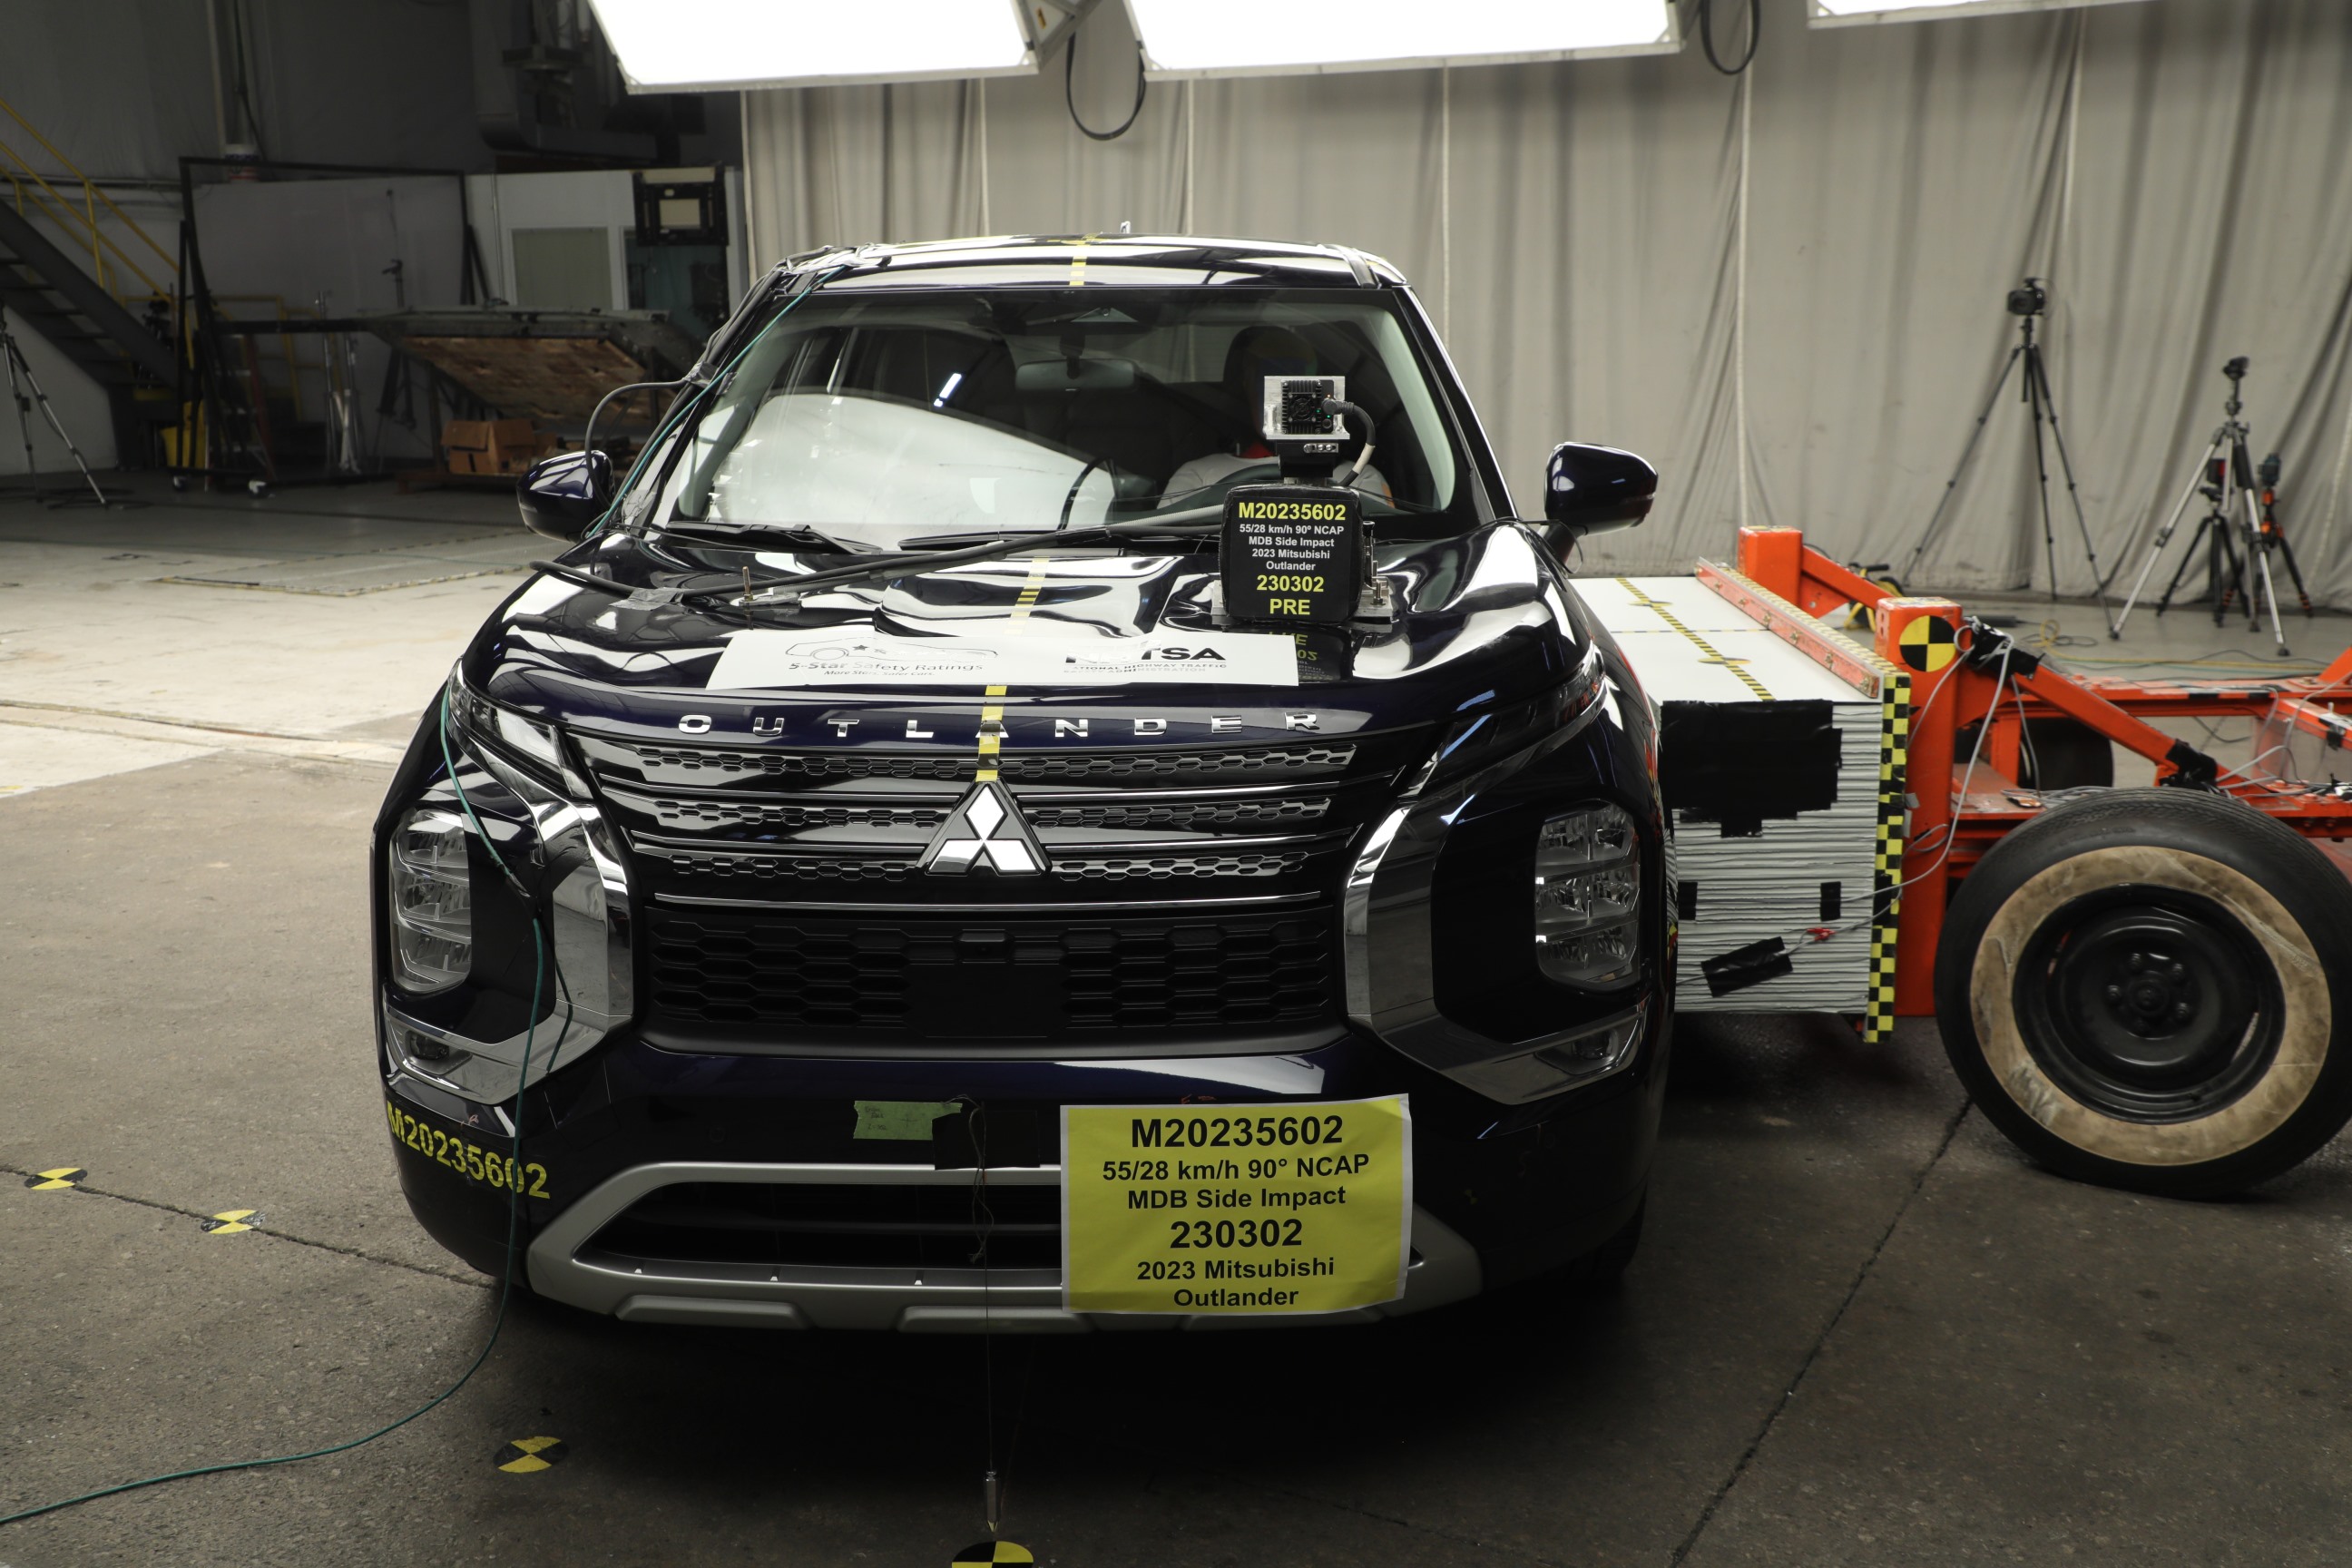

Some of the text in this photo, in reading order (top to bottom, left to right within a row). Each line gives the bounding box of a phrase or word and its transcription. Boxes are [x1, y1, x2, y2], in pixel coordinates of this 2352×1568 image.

[1239, 502, 1346, 521] M20235602
[1240, 524, 1265, 534] 55/28
[1269, 524, 1292, 534] km/h
[1314, 525, 1344, 534] NCAP
[1249, 536, 1335, 548] MDB Side Impact
[1252, 548, 1330, 559] 2023 Mitsubishi
[1266, 561, 1316, 571] Outlander
[1257, 574, 1324, 593] 230302
[1269, 598, 1310, 615] PRE
[789, 661, 983, 671] 5-Star Safety Ratings
[679, 711, 1320, 739] OUTLANDER
[1132, 1115, 1343, 1148] M20235602
[387, 1101, 550, 1199] M20235602
[1102, 1153, 1370, 1181] 55/28 km/h 90° NCAP
[1128, 1186, 1347, 1210] MDB Side Impact
[1170, 1218, 1303, 1249] 230302
[1137, 1257, 1335, 1280] 2023 Mitsubishi
[1173, 1287, 1299, 1307] Outlander
